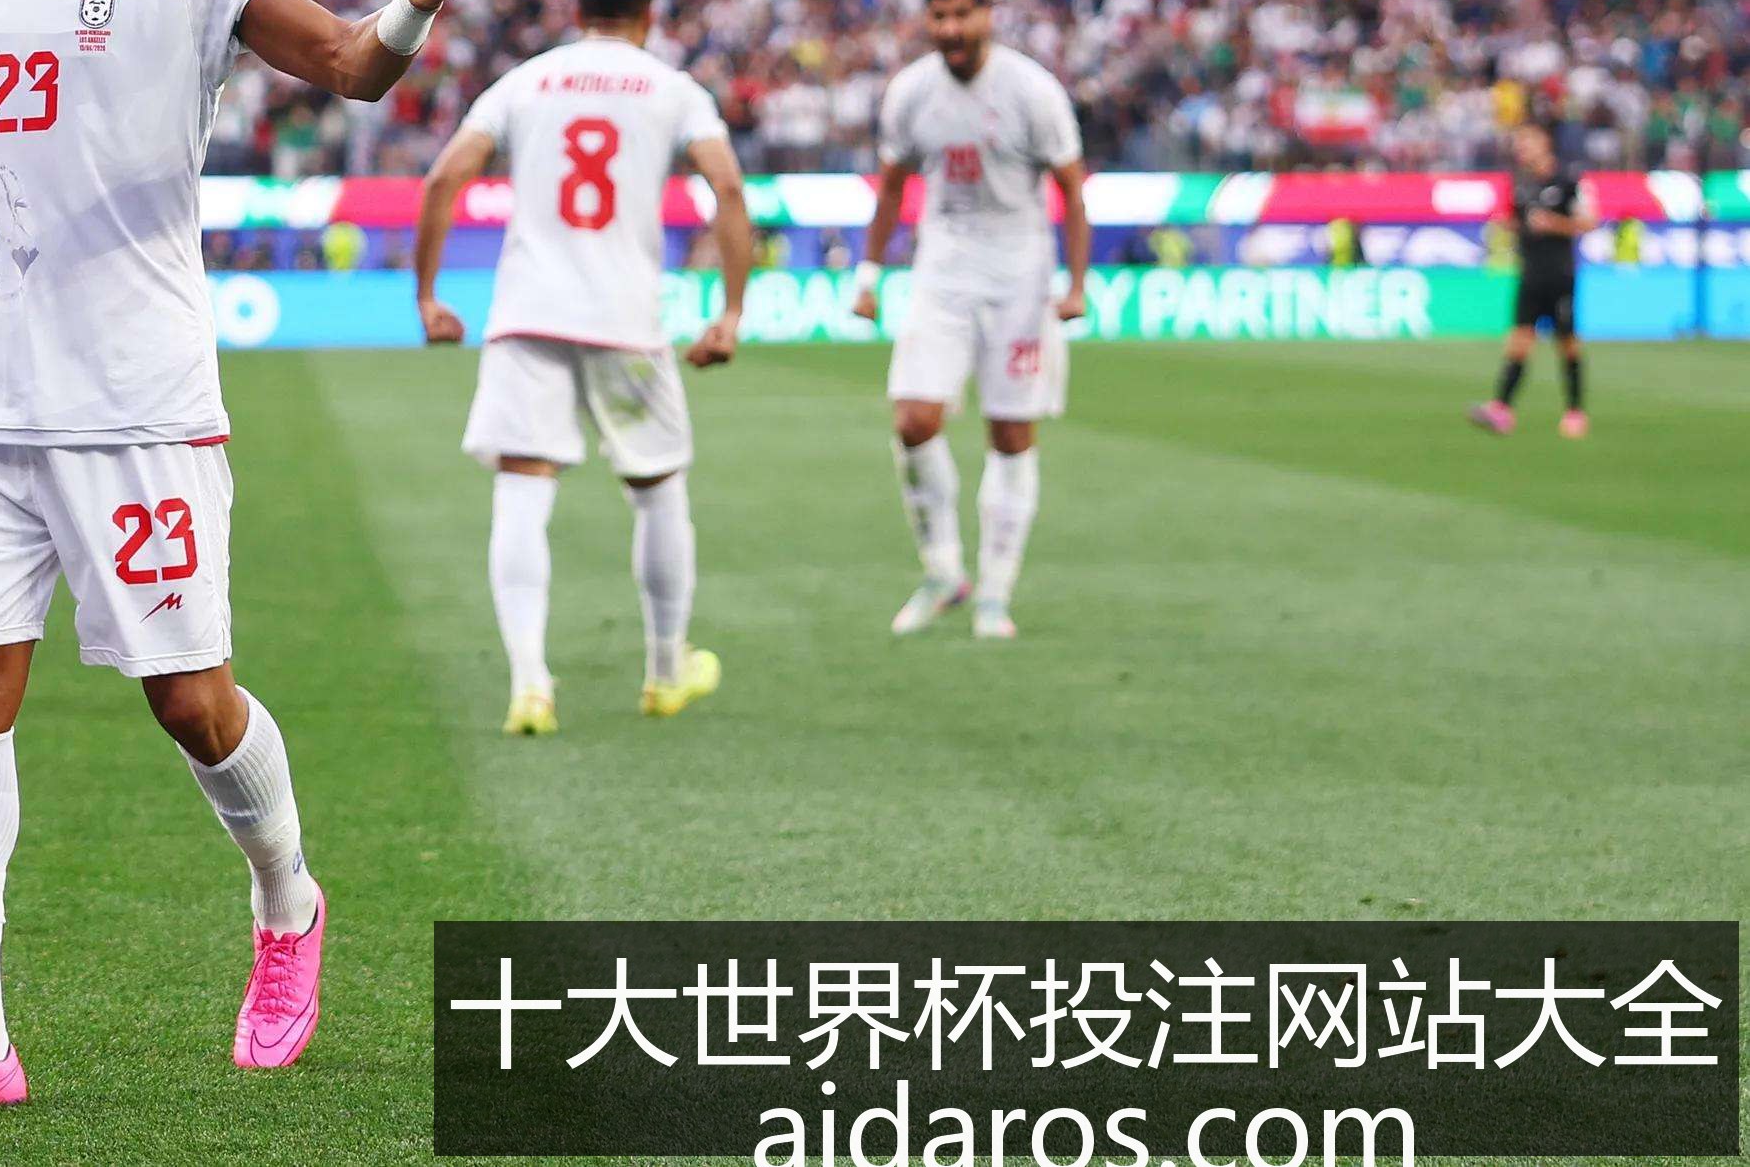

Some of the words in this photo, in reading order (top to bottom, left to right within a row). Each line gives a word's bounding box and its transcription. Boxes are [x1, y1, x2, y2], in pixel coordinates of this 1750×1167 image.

[559, 116, 620, 231] 8
[655, 268, 878, 344] GLBAL
[1138, 267, 1433, 341] PARTNER
[112, 497, 199, 585] 23
